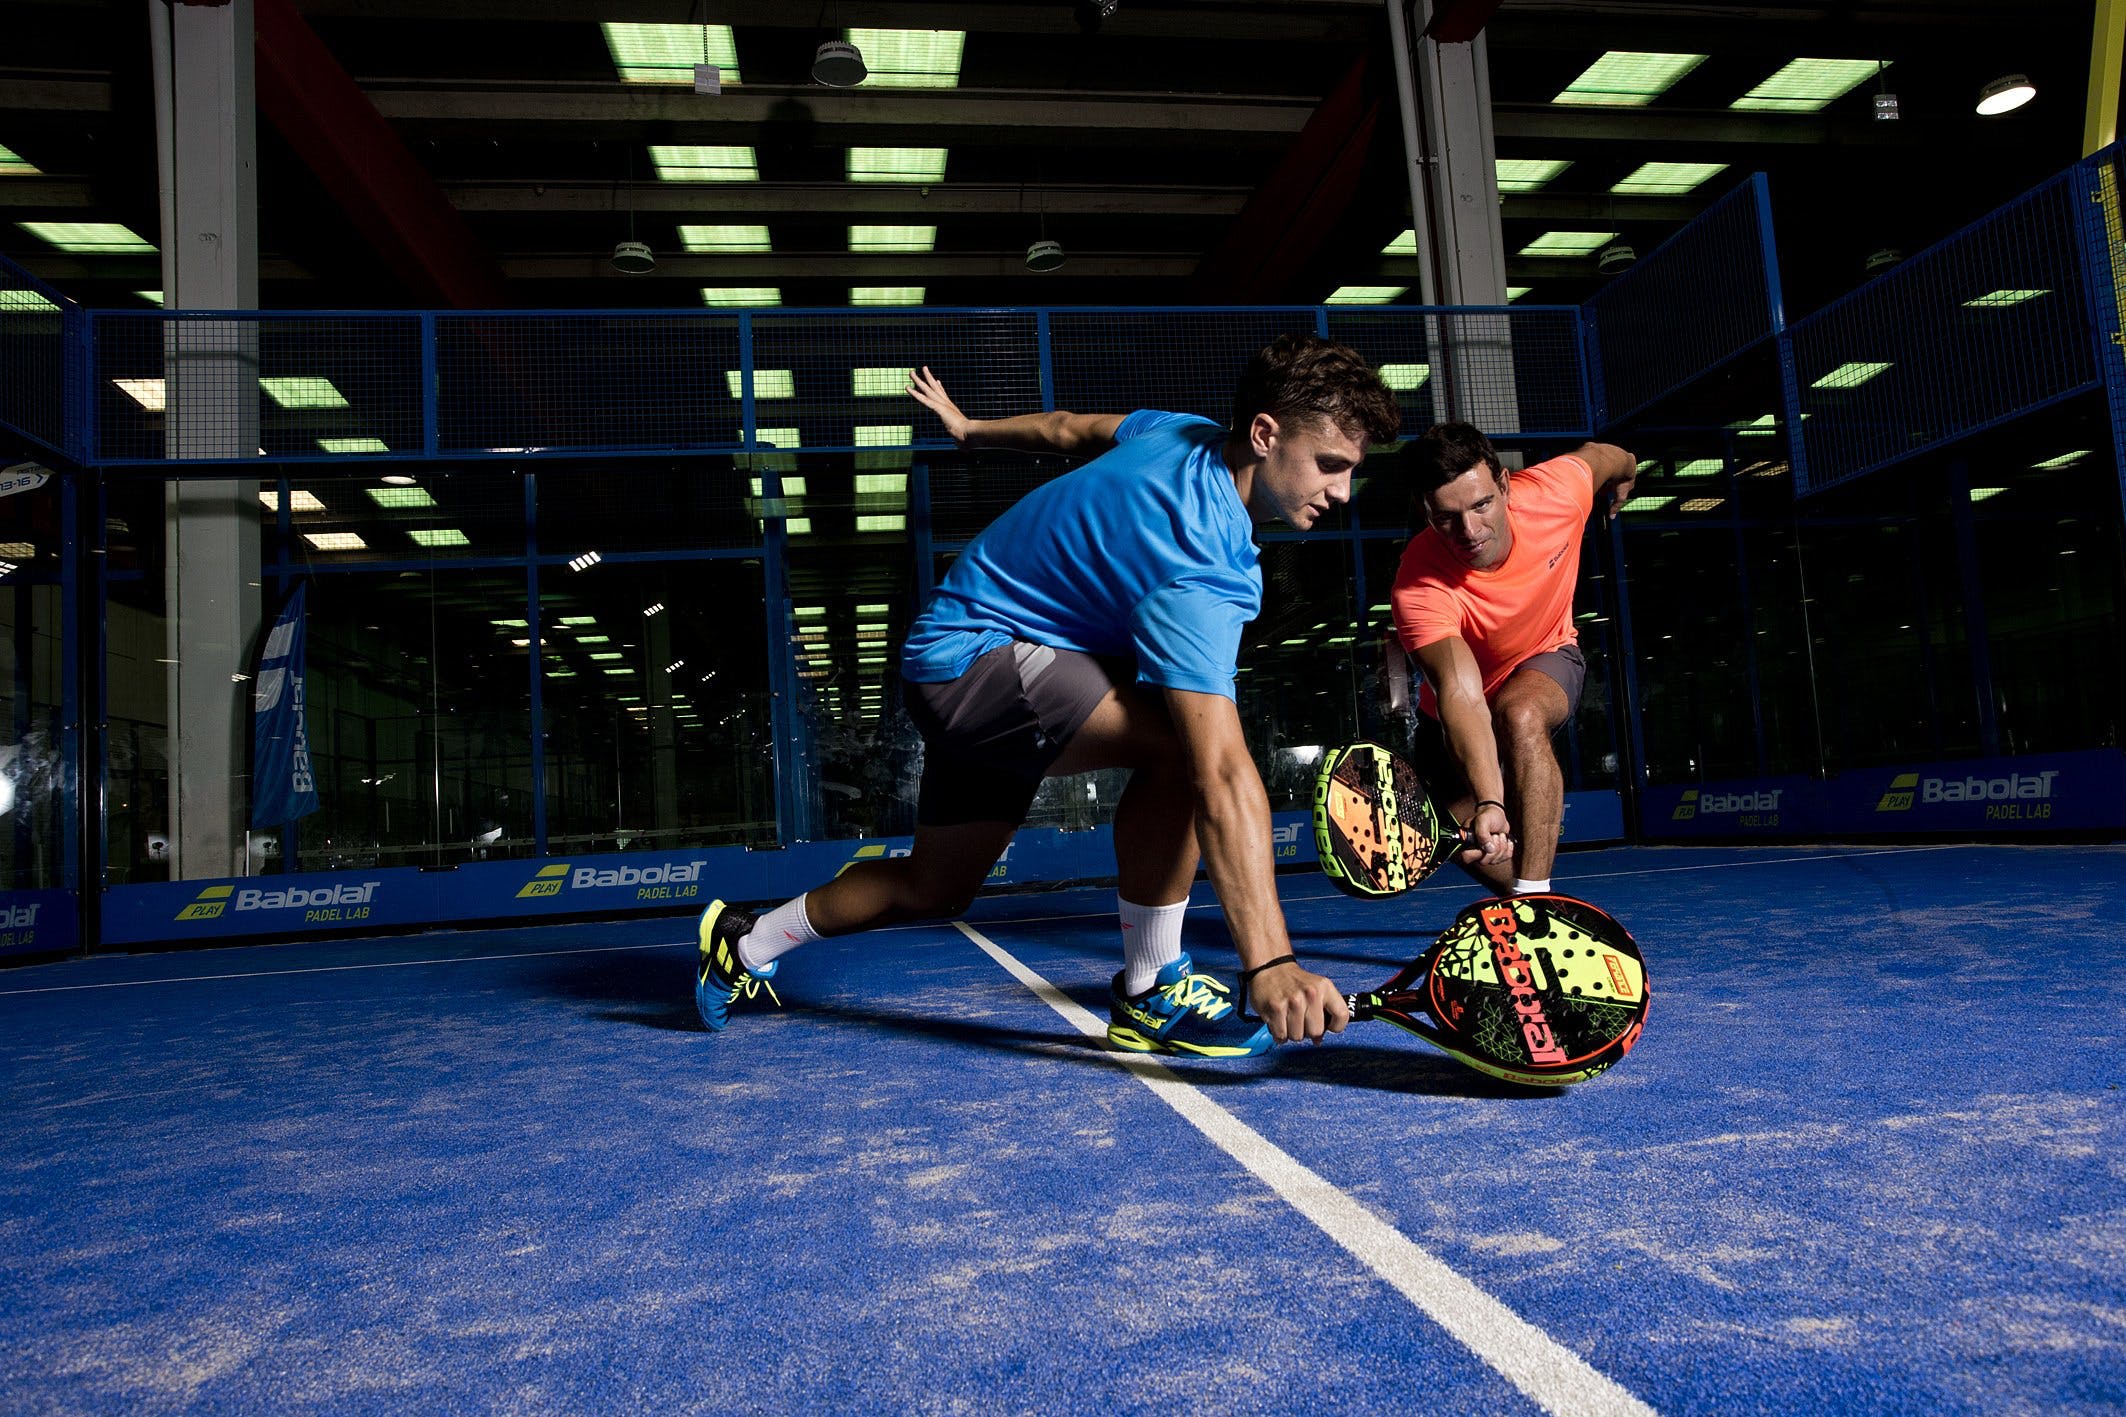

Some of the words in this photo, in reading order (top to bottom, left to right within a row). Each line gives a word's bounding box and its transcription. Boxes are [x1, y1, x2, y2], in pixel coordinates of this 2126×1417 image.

[1887, 794, 1912, 808] PLAY
[1986, 804, 2022, 821] PADEL
[2026, 802, 2052, 818] LAB
[1277, 844, 1297, 857] LAB
[530, 883, 559, 895] PLAY
[637, 886, 672, 901] PADEL
[675, 884, 699, 898] LAB
[190, 905, 220, 917] PLAY
[304, 909, 343, 923] PADEL
[345, 907, 371, 920] LAB
